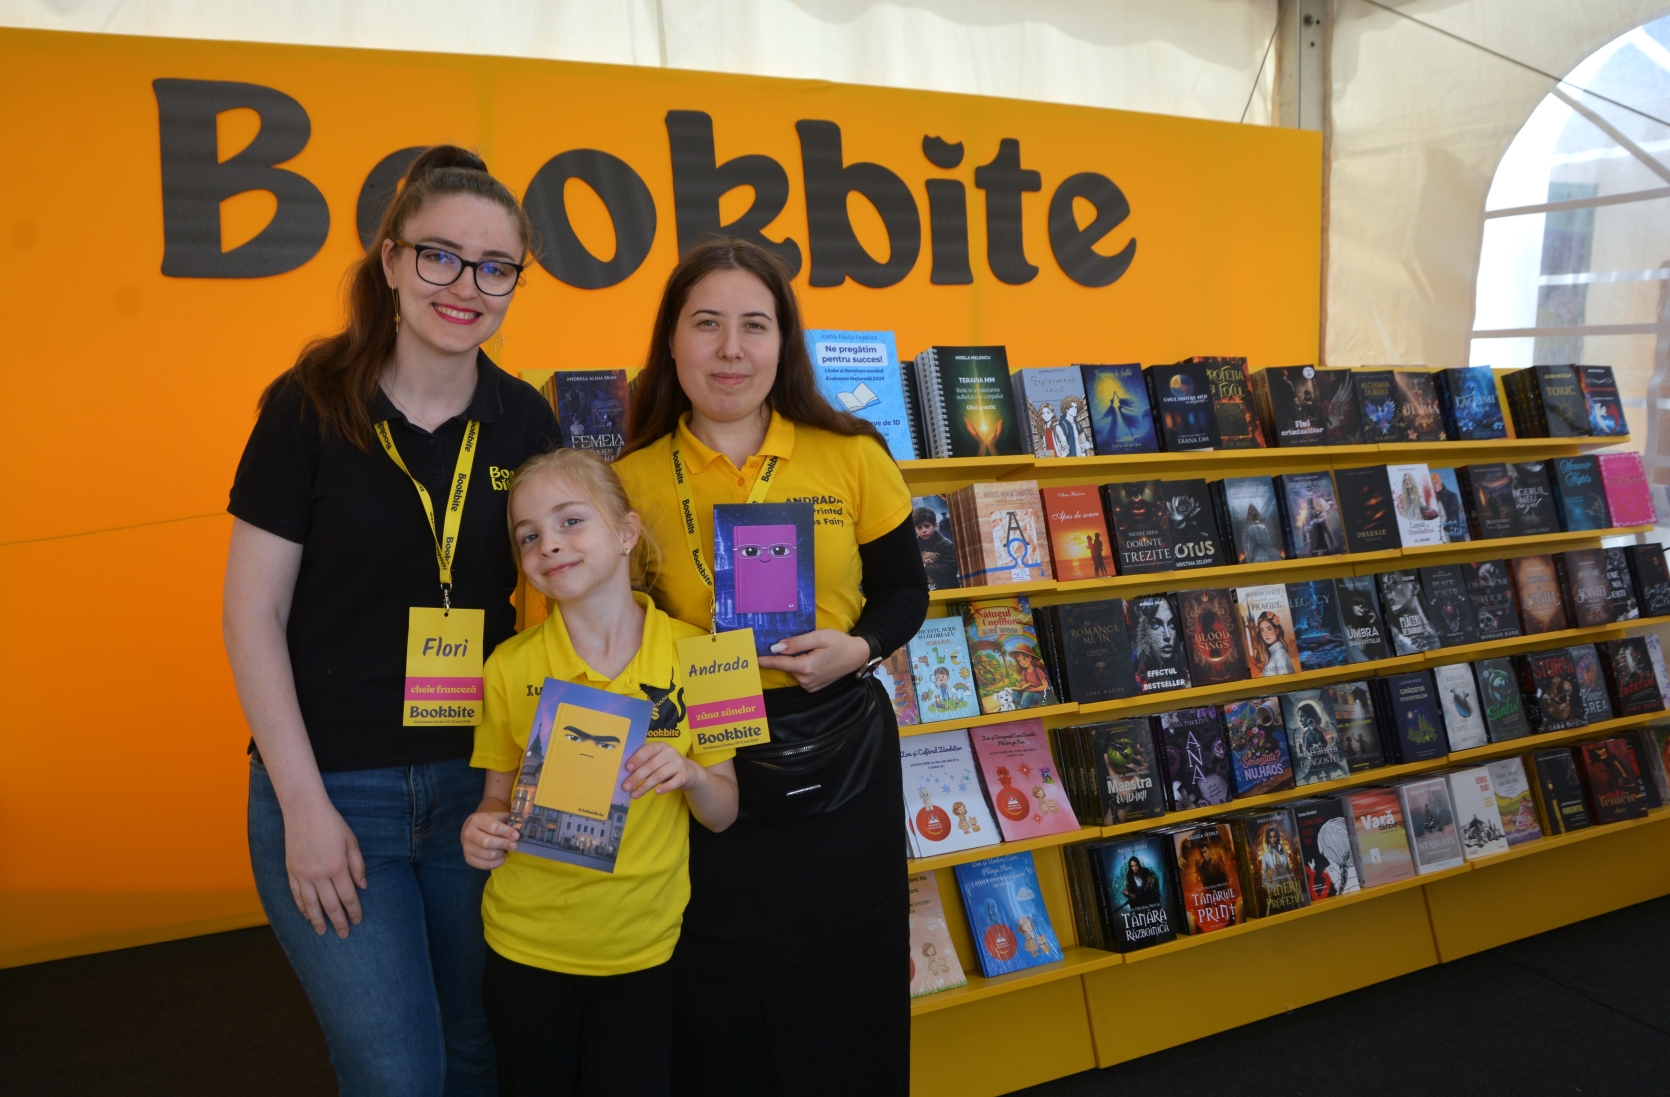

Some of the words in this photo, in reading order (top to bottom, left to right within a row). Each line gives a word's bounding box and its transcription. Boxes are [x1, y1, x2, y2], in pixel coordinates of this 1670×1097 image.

[825, 345, 837, 353] Ne
[839, 345, 877, 355] pregătim
[822, 356, 851, 364] pentru
[1546, 385, 1577, 397] TOXIC
[464, 420, 477, 452] ookbite
[571, 433, 625, 449] FEMEIA
[672, 450, 684, 485] Bookbite
[450, 473, 467, 512] Bookbite
[1512, 486, 1549, 497] NGERUL
[682, 498, 695, 535] Bookbite
[814, 507, 843, 515] rinted
[1051, 510, 1073, 523] Apus
[1073, 510, 1082, 519] de
[1082, 511, 1100, 519] soare
[823, 518, 844, 527] Fairy
[1356, 528, 1387, 538] OBSESIE
[1126, 538, 1163, 549] DORINȚE
[1174, 540, 1215, 559] OTUS
[1123, 548, 1172, 563] TREZITE
[692, 548, 713, 587] Bookbite
[1176, 559, 1196, 567] KRISTINA
[1251, 601, 1282, 611] PRAGUE
[1289, 594, 1330, 609] LEGACY
[1071, 624, 1121, 638] ROMANCE
[1194, 632, 1230, 643] BLOOD
[1347, 626, 1380, 639] UMBRA
[1083, 635, 1098, 644] ME
[1099, 633, 1113, 643] IN
[1199, 640, 1230, 651] SINGS
[422, 636, 469, 657] Flori
[688, 656, 749, 678] Andrada
[1147, 667, 1178, 678] EFECTUL
[410, 684, 435, 693] cheie
[436, 684, 477, 693] franceză
[526, 684, 542, 696] Iu
[1143, 679, 1186, 690] BESTSELLER
[409, 705, 476, 719] Bookbite
[696, 709, 720, 721] zâna
[720, 704, 756, 718] zânelor
[1487, 694, 1520, 721] Sinful
[647, 728, 681, 738] ookbite
[697, 725, 762, 745] Bookbite
[1242, 750, 1281, 769] Seriozitate?
[1258, 763, 1284, 779] HAOS
[1106, 777, 1153, 795] Maestra
[1360, 810, 1396, 830] Vară
[1378, 822, 1398, 831] târzie
[1419, 835, 1456, 851] STARGATE
[1191, 888, 1236, 907] TÂNĂRUL
[1121, 908, 1168, 929] TÂNĂRA
[1197, 902, 1236, 924] PRINȚ
[1125, 922, 1170, 941] RĂZBOINICĂ
